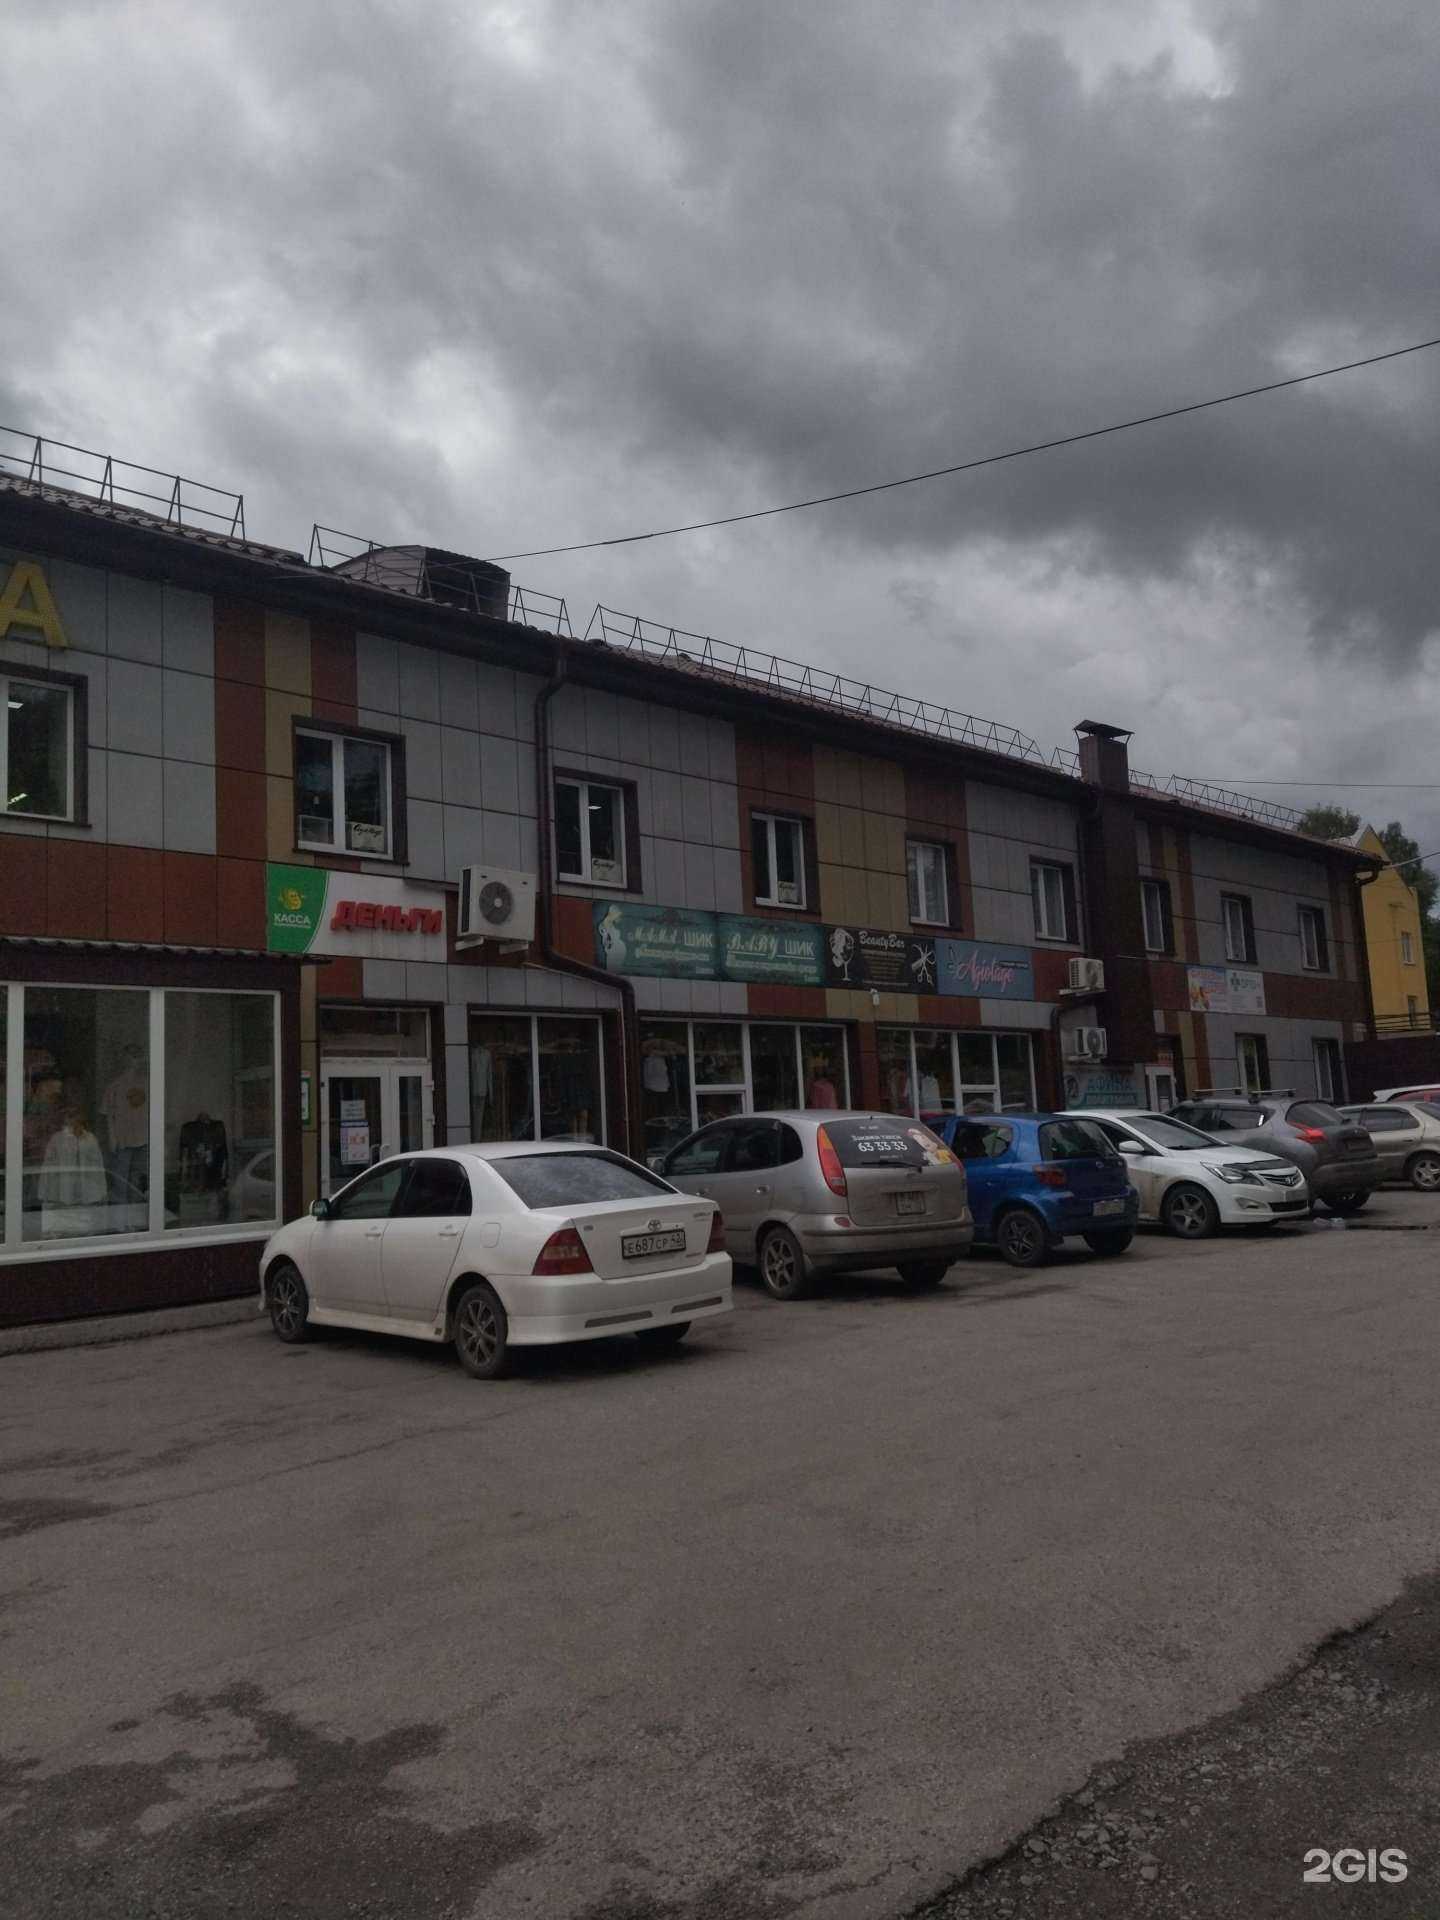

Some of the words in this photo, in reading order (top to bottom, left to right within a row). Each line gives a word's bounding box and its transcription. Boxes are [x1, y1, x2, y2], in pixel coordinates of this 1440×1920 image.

[273, 912, 311, 925] КАССА
[330, 901, 443, 934] ДЕНЬГИ
[682, 929, 712, 948] ШИК
[784, 939, 816, 957] ШИК
[857, 1142, 874, 1152] 63
[874, 1141, 891, 1151] 33
[891, 1141, 908, 1151] 33
